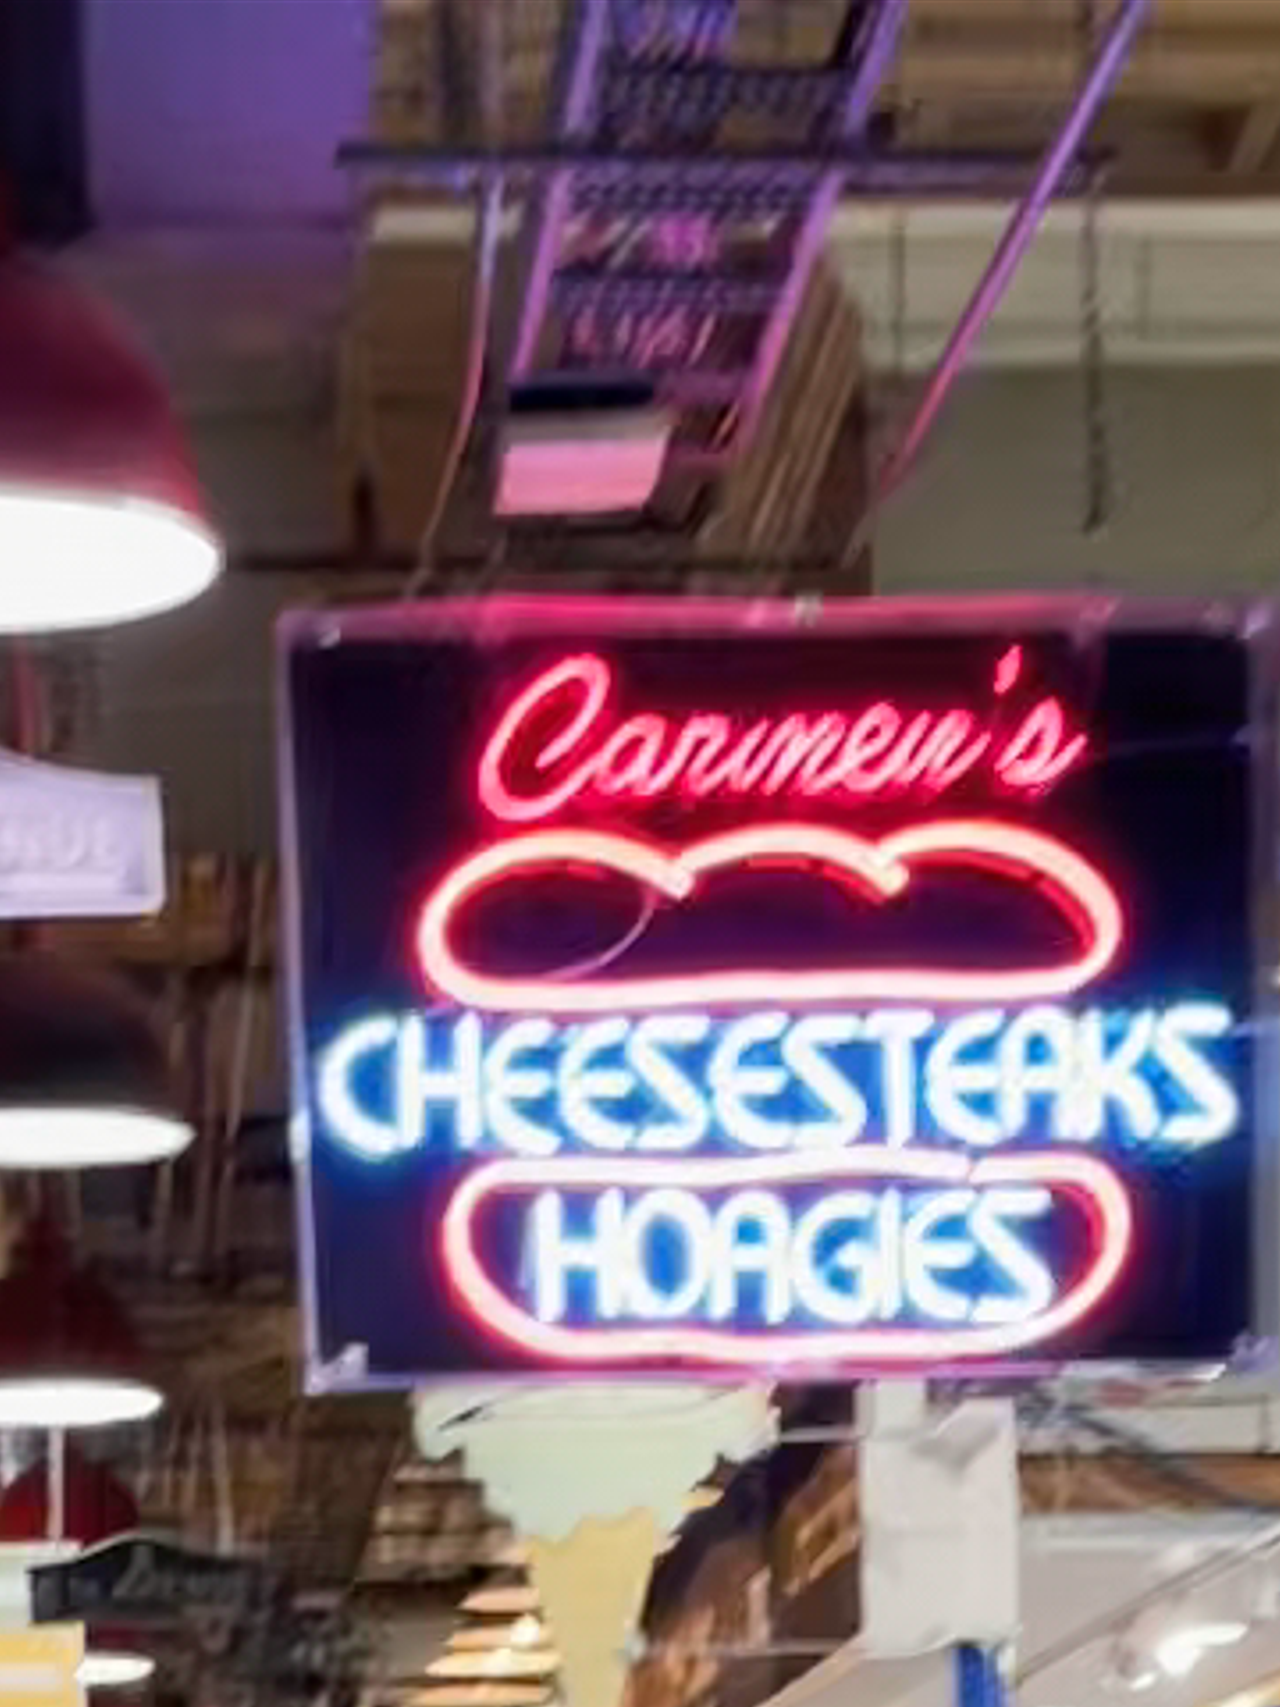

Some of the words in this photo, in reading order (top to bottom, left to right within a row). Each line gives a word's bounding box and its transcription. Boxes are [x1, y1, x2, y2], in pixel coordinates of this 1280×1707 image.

[477, 643, 1088, 822] Carmen's
[320, 1004, 1239, 1161] CHEESESTEAKS
[532, 1186, 1058, 1325] HOAGIES
